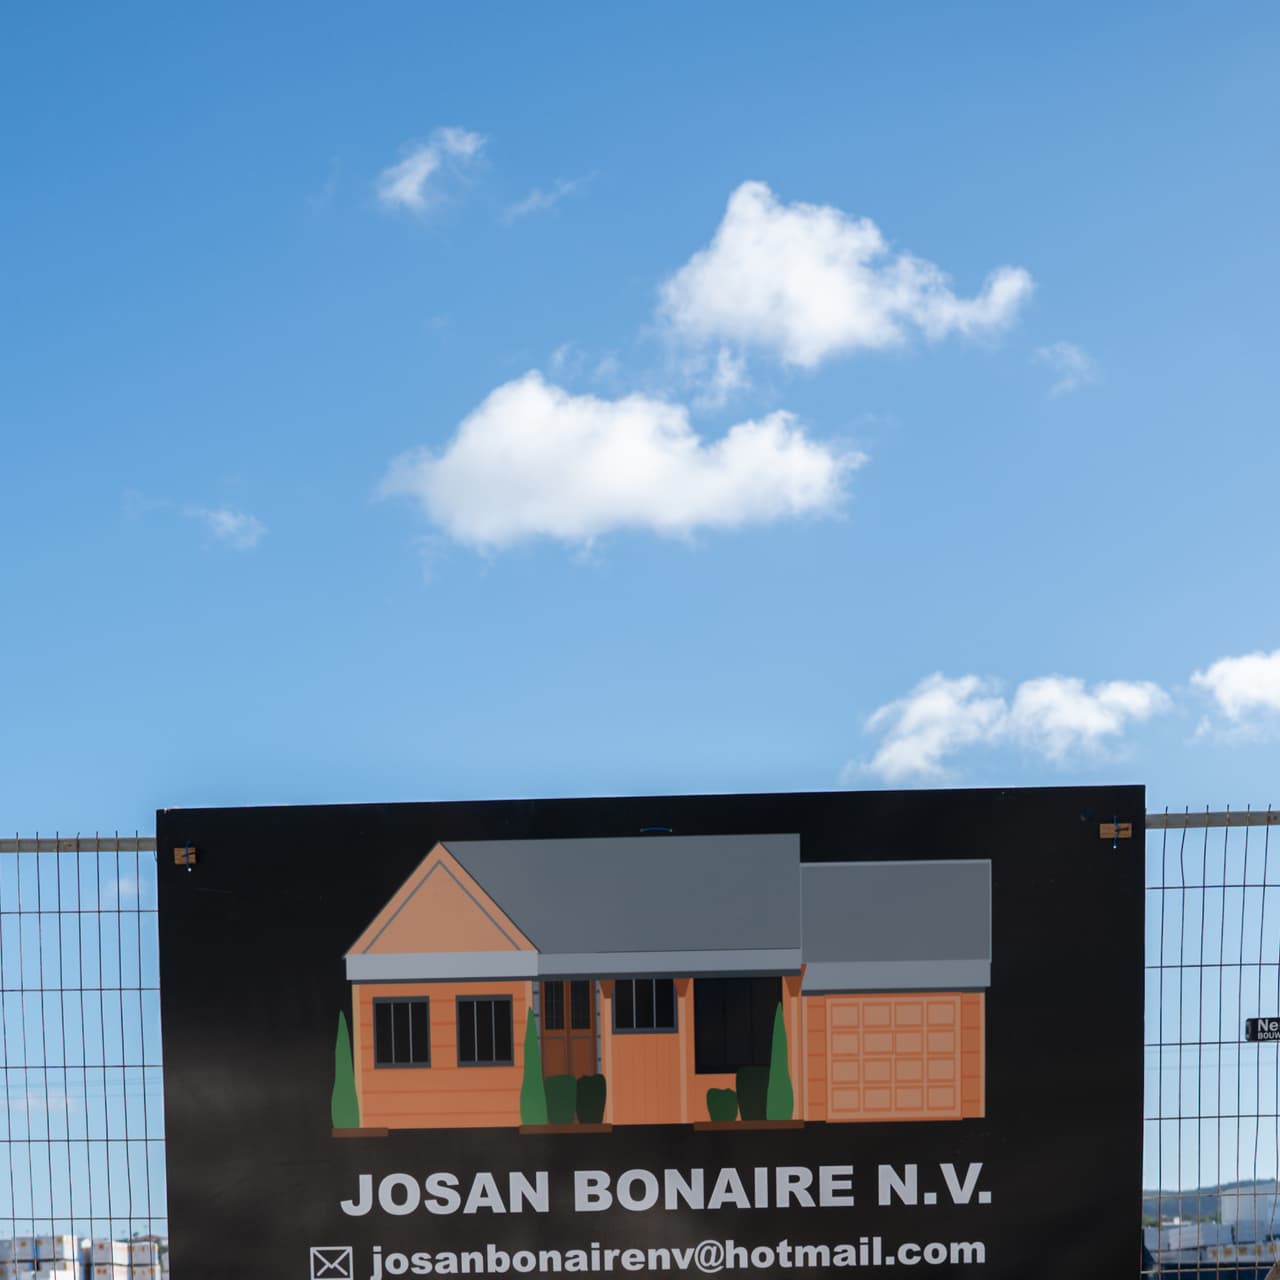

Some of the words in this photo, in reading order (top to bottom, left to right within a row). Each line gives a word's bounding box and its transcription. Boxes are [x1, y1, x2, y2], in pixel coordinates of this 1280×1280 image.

[340, 1171, 550, 1217] JOSAN
[574, 1165, 855, 1212] BONAIRE
[878, 1162, 992, 1206] N.V.
